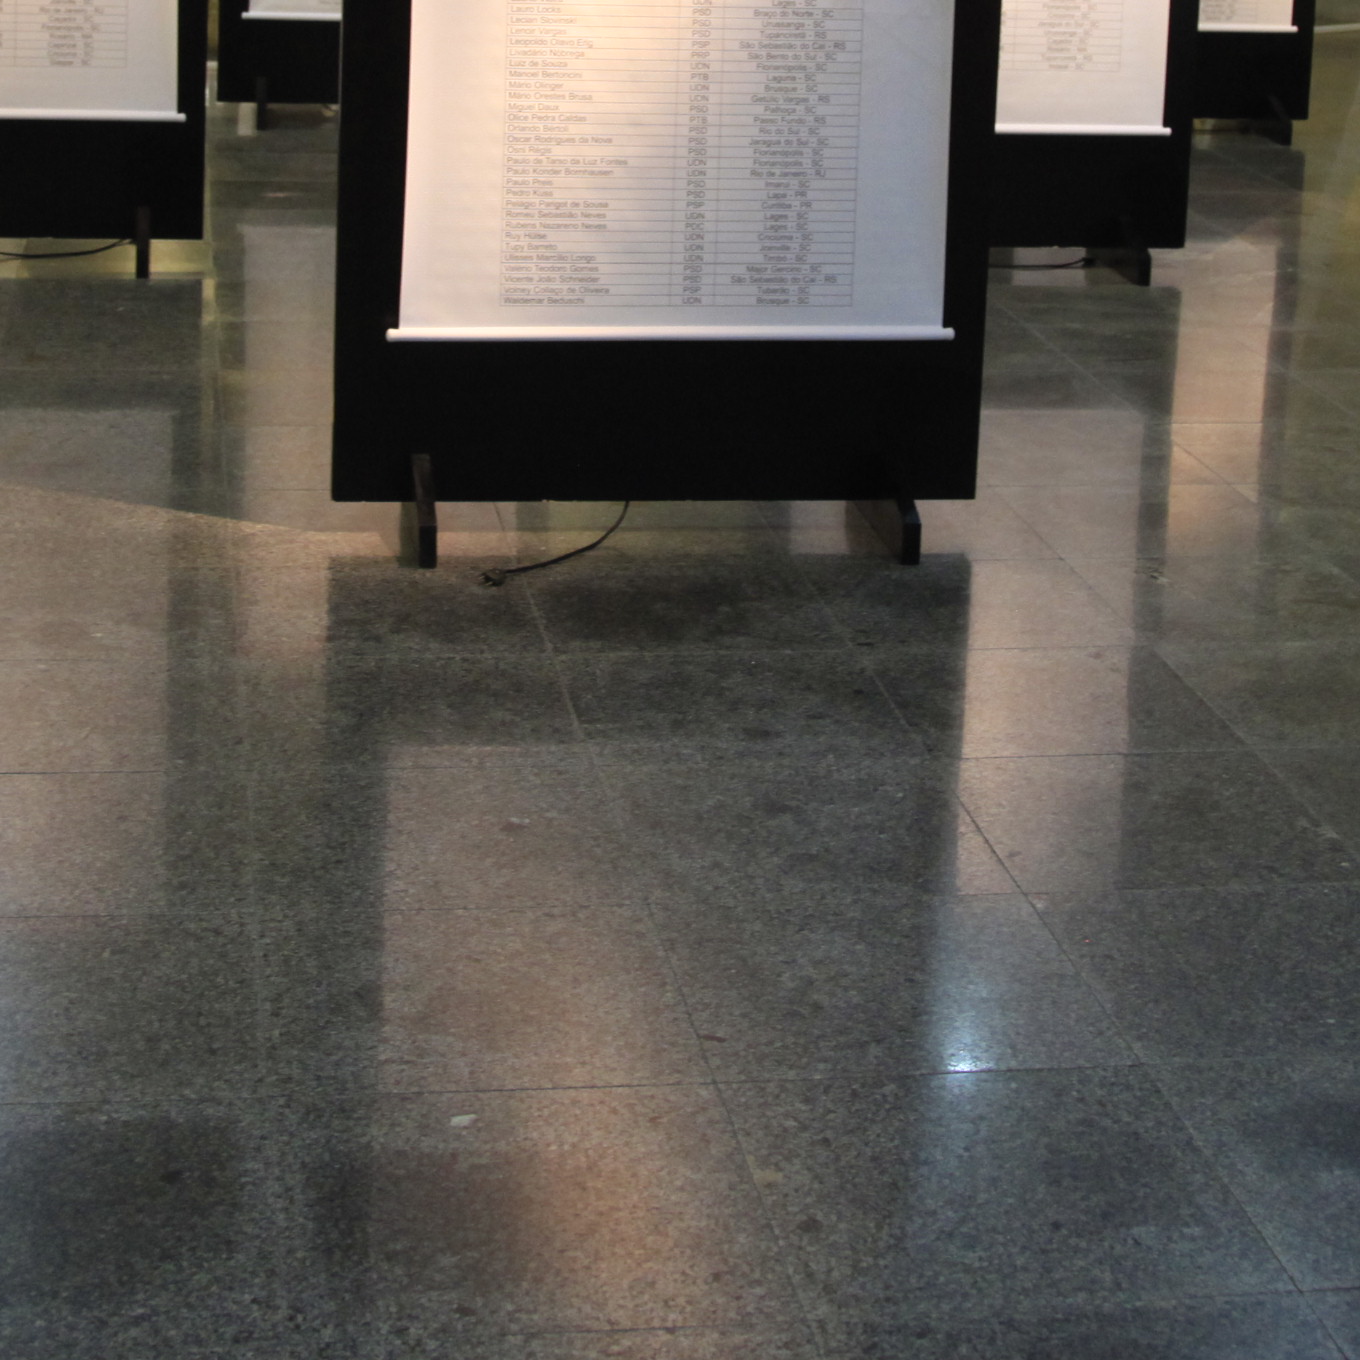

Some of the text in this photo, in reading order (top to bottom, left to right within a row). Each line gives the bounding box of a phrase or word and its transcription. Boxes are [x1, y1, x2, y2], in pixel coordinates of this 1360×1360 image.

[509, 5, 534, 13] Lauro
[691, 8, 711, 16] PSD
[527, 60, 539, 68] de
[540, 60, 567, 68] Souza
[689, 62, 710, 70] UDN
[507, 92, 531, 100] Mário
[567, 93, 592, 101] Brusa
[688, 94, 709, 102] UDN
